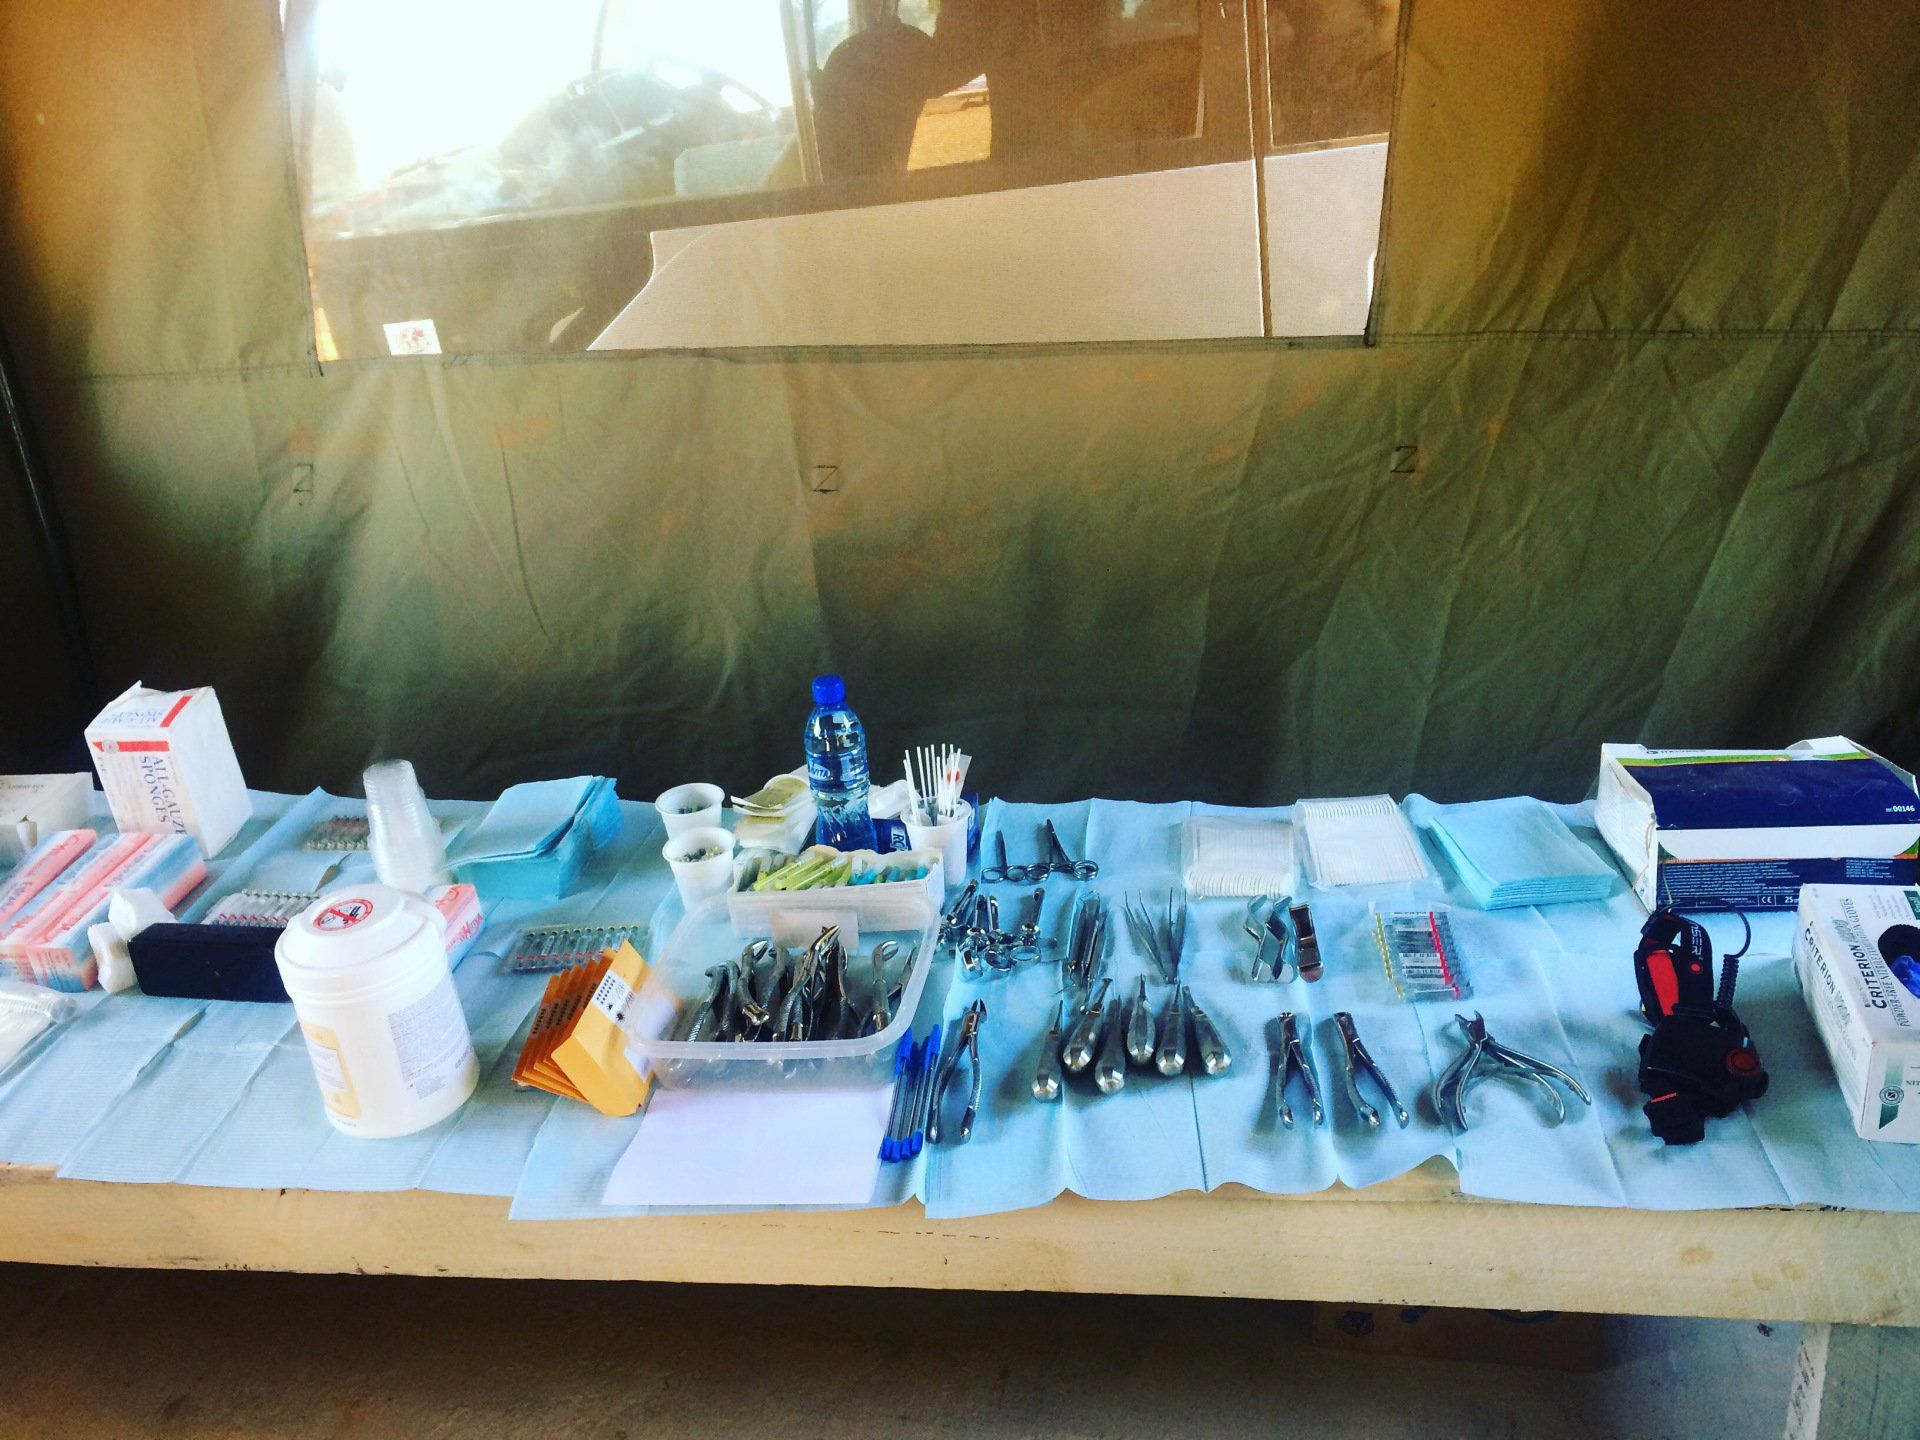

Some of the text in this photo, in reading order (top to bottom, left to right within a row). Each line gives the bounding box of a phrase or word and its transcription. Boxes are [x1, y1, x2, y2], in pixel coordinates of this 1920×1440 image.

[140, 756, 169, 823] SPONGES
[1804, 927, 1836, 995] CRITERION
[1850, 945, 1887, 1009] CRITERION
